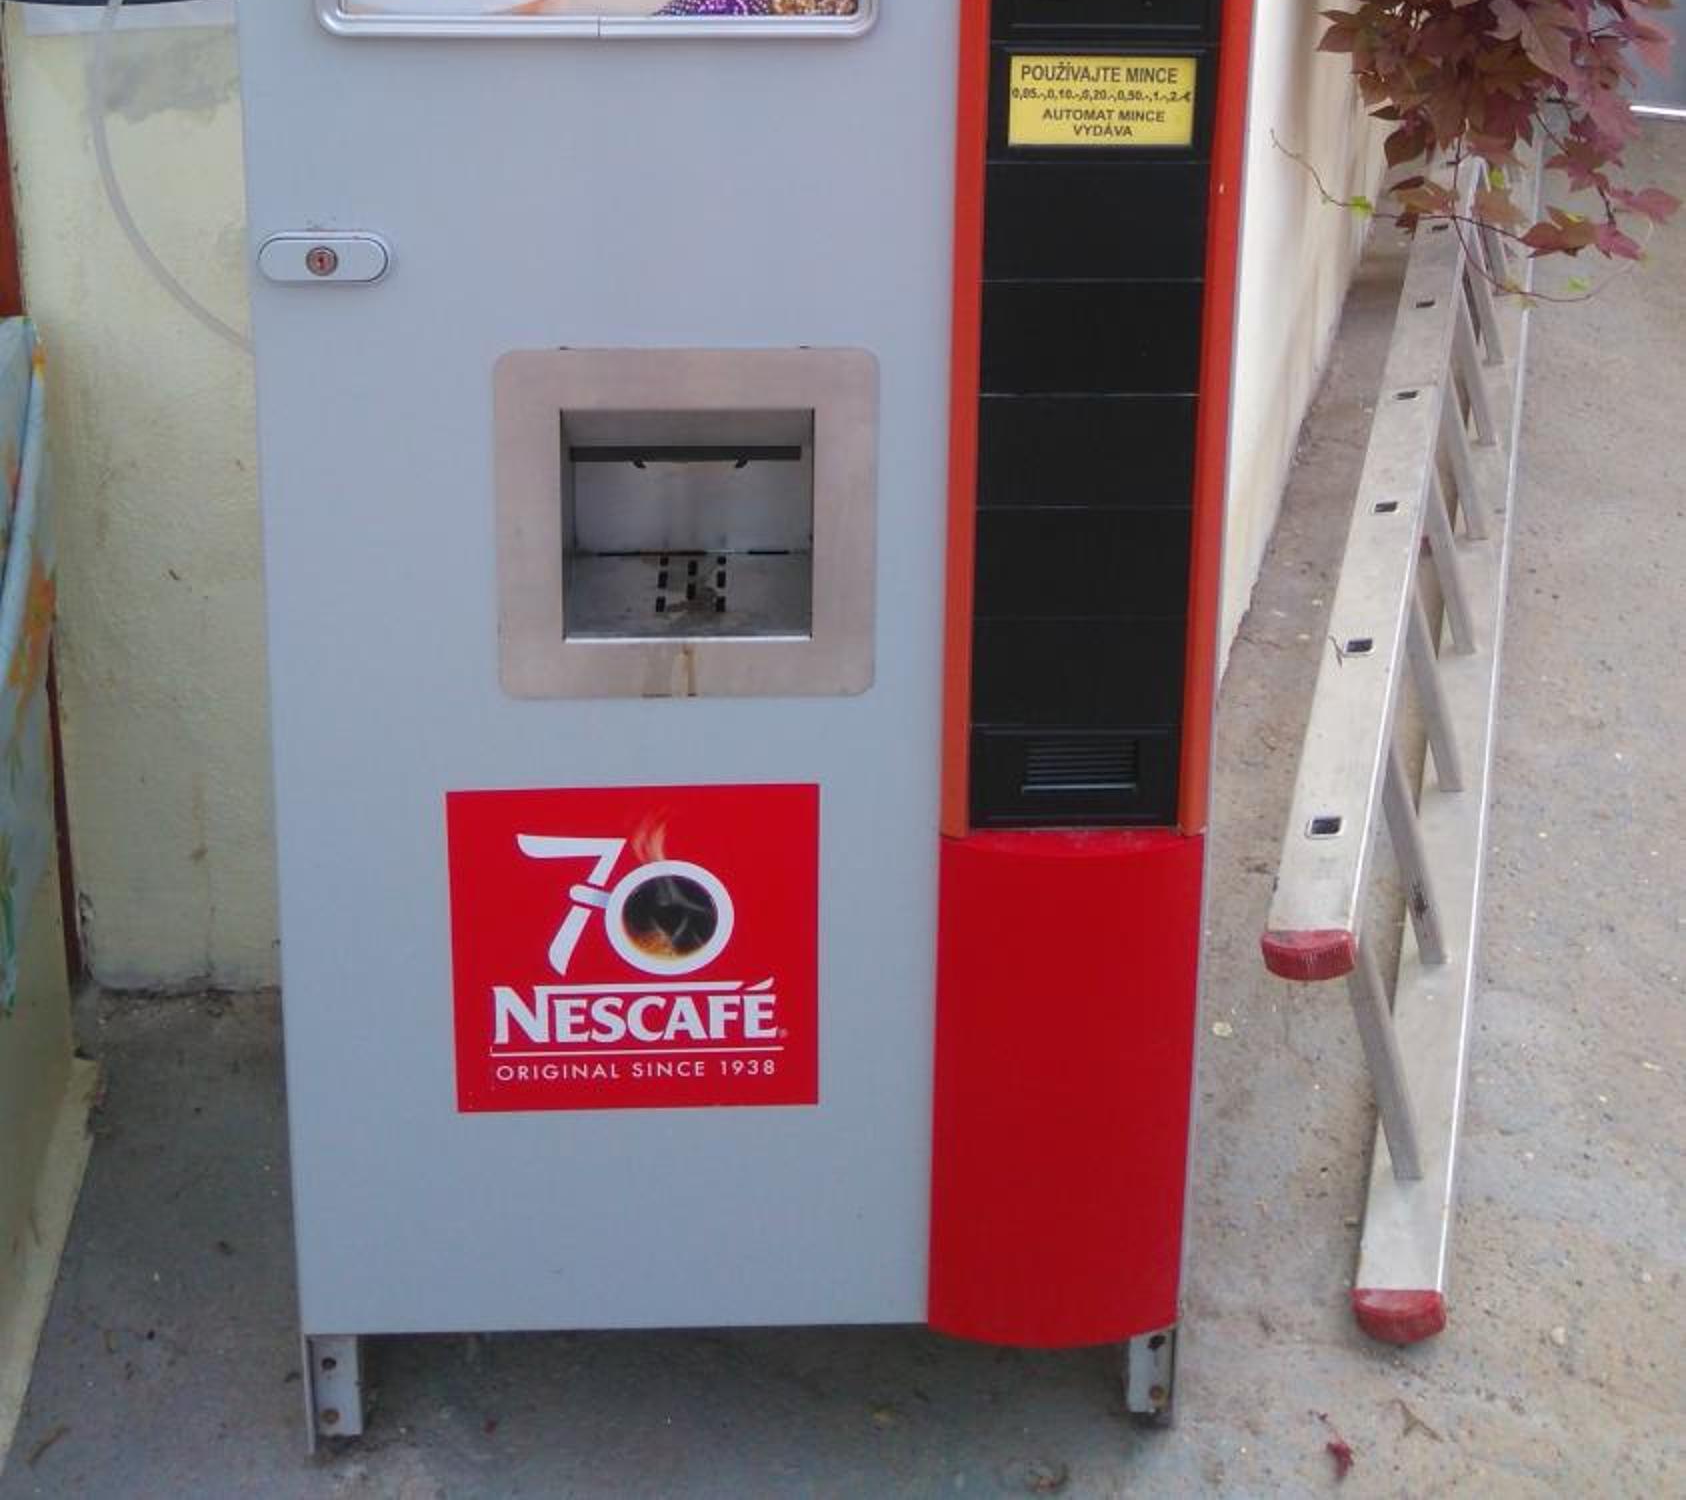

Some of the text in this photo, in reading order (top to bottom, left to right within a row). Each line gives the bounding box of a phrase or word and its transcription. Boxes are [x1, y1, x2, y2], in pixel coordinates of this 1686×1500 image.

[1021, 62, 1178, 84] POUŽÍVAJTE MINCE
[1042, 108, 1165, 123] AUTOMAT MINCE
[491, 977, 779, 1046] NESCAFÉ
[496, 1059, 776, 1082] ORIGINAL SINCE 1938
